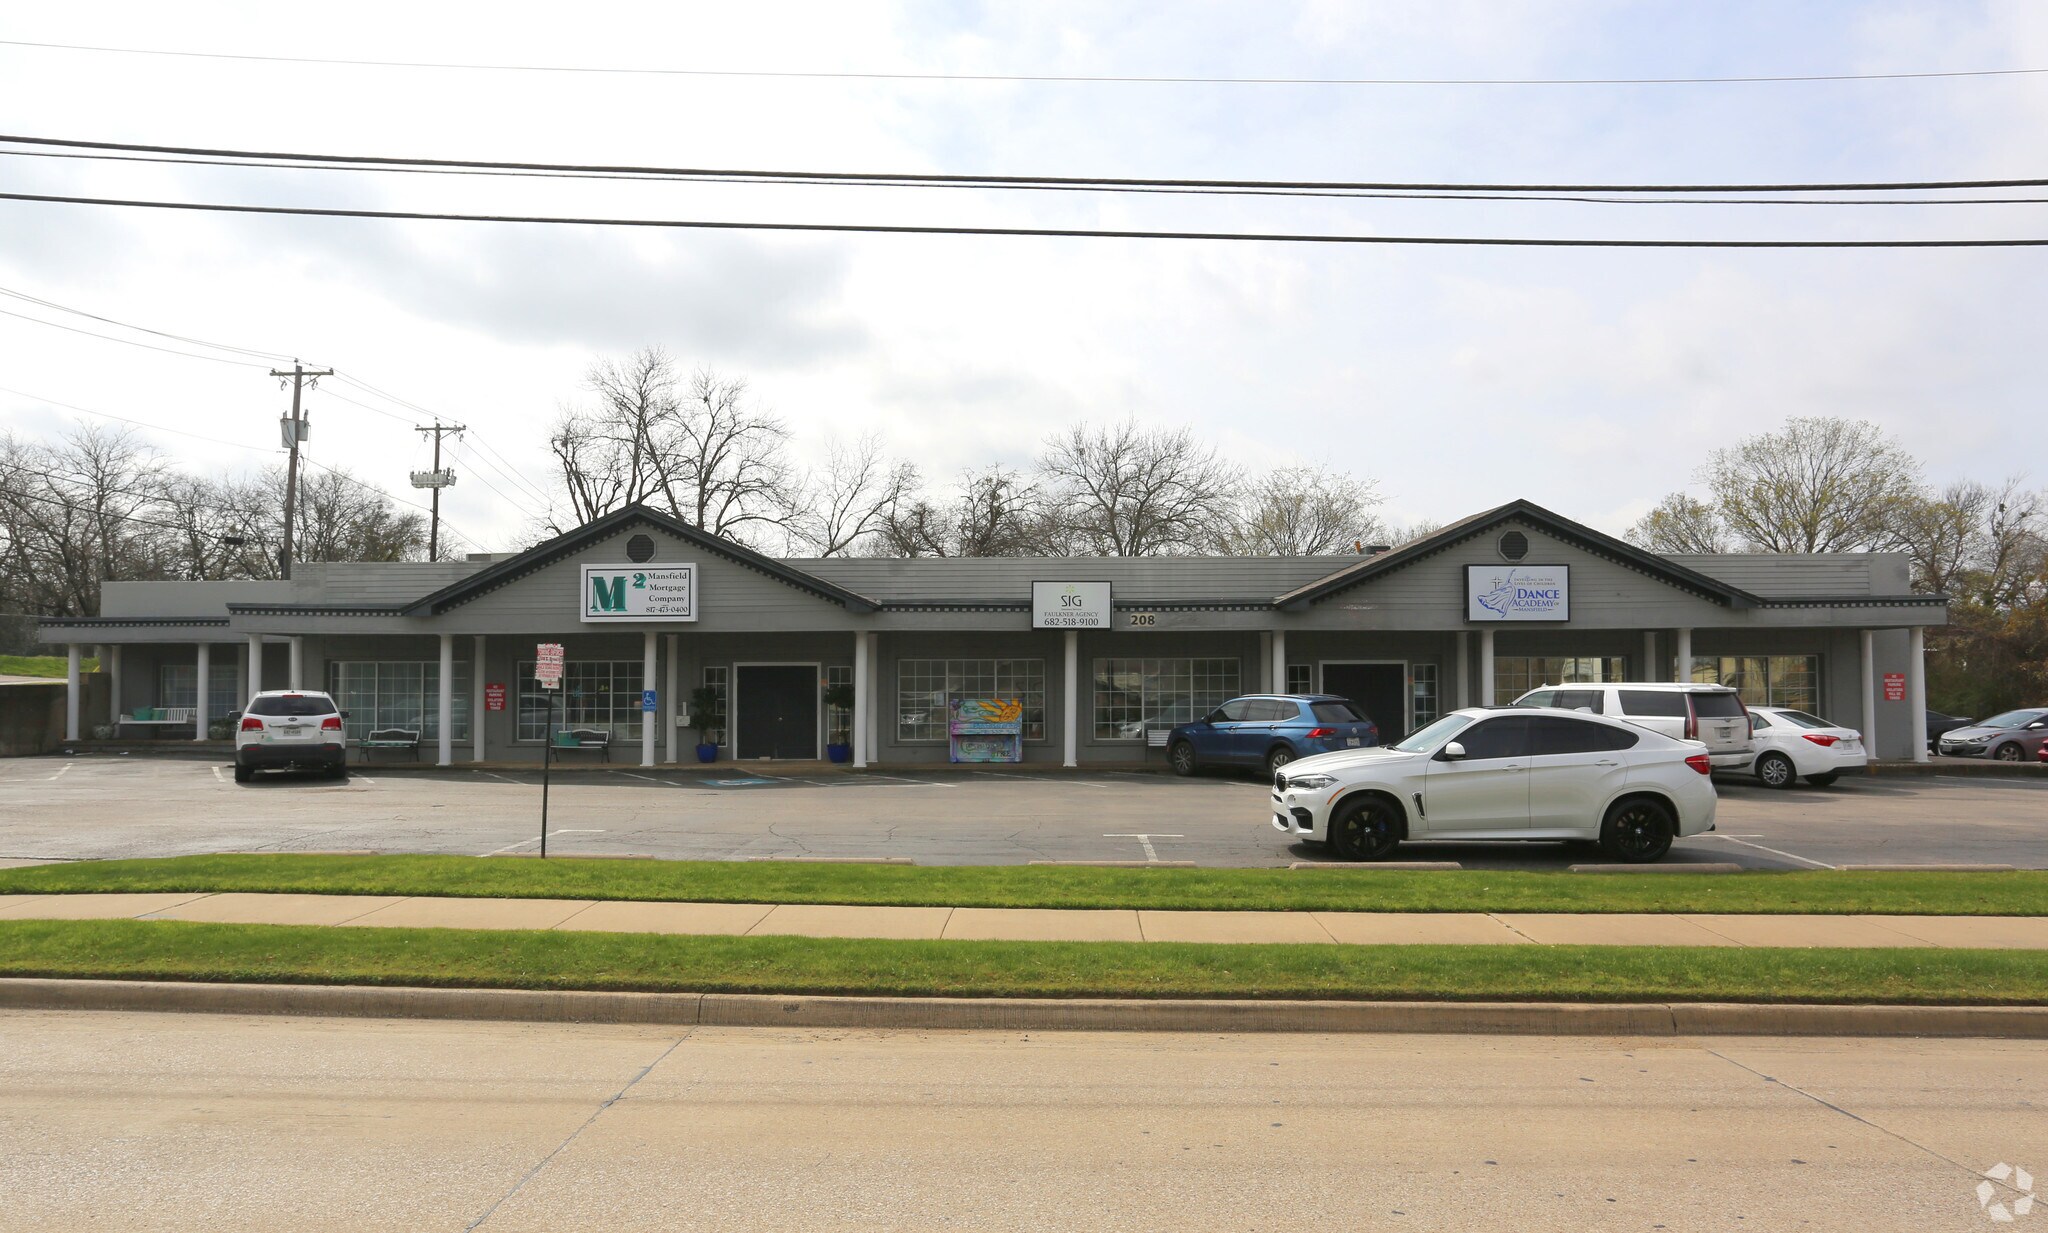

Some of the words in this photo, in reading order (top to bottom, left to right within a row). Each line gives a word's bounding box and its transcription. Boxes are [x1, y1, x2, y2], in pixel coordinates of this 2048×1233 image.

[648, 572, 687, 580] Mansfield
[649, 584, 686, 592] Mortgage
[1517, 588, 1560, 599] DANCE
[648, 595, 686, 603] Company
[1061, 595, 1082, 607] SIG
[1044, 618, 1099, 626] 682-518-9100
[1130, 615, 1155, 626] 208
